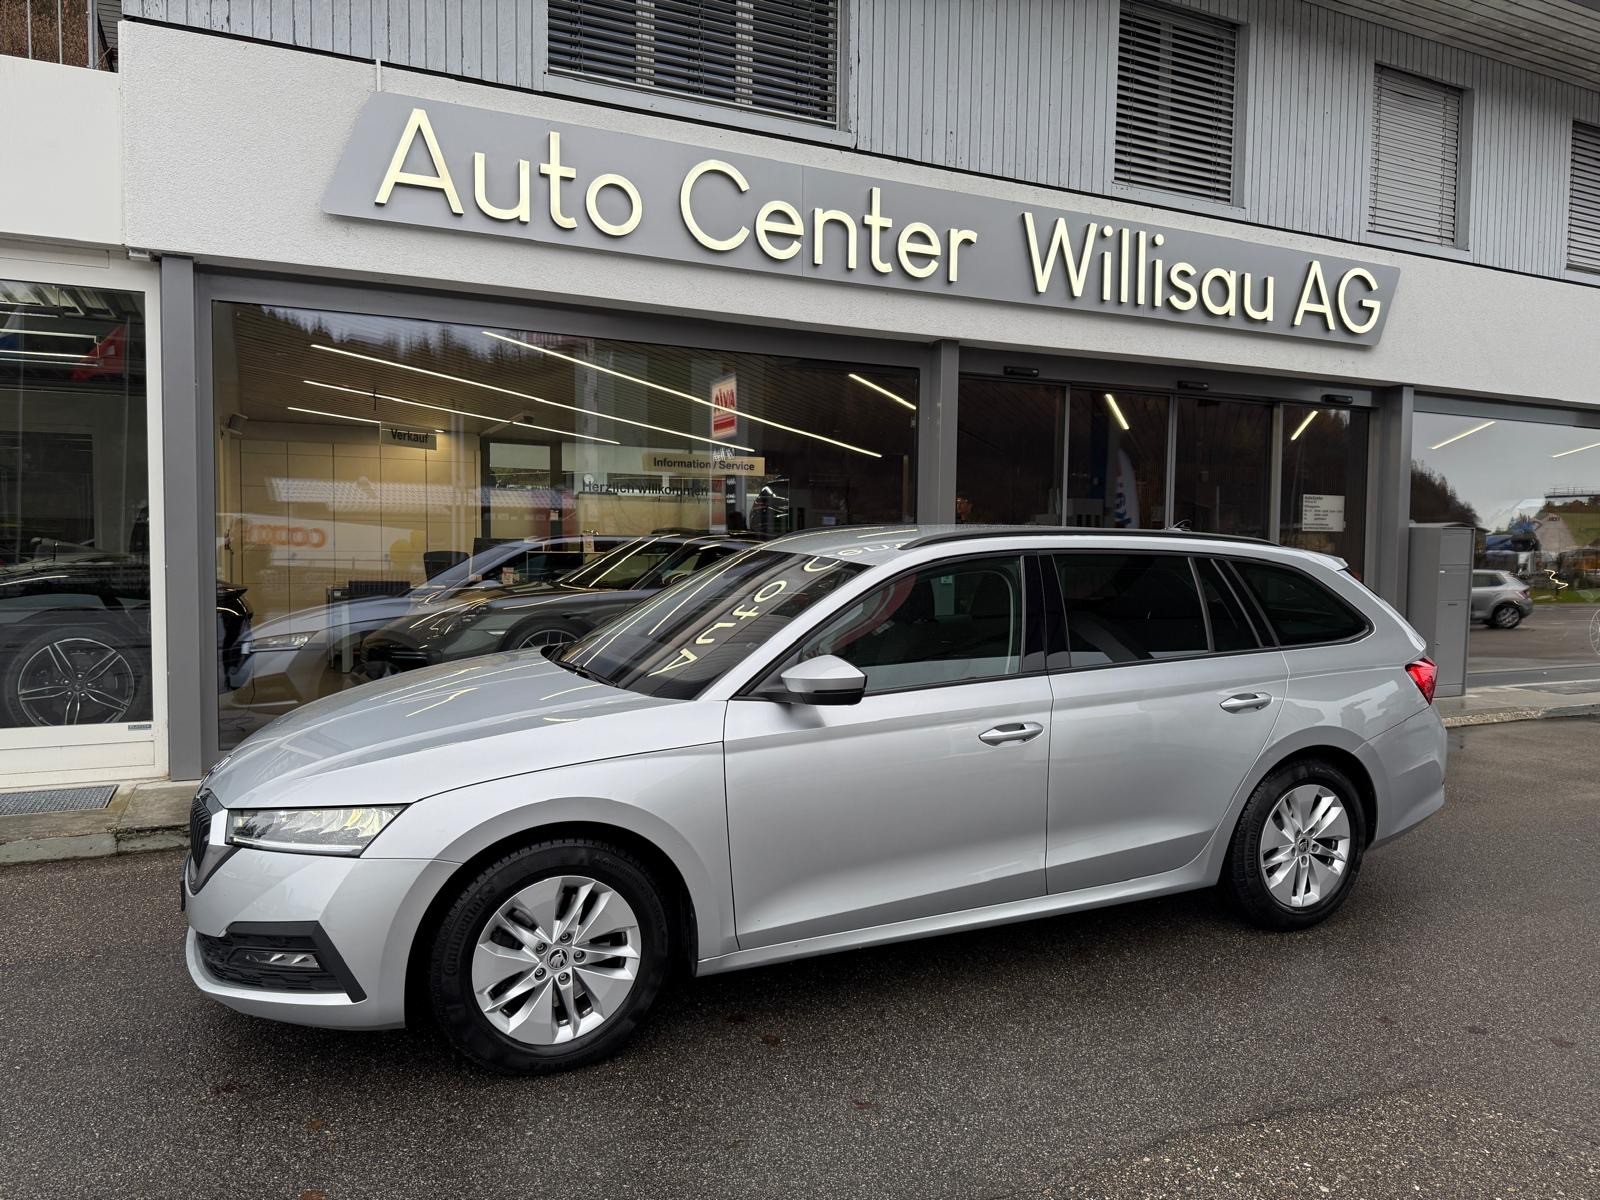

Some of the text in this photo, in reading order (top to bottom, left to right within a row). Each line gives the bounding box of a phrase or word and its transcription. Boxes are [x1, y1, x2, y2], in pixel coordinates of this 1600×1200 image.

[377, 107, 1382, 335] Auto Center Willisau AG
[391, 428, 428, 443] Verkauf
[653, 456, 710, 470] Information
[718, 460, 756, 471] Service
[582, 480, 709, 496] Herzlich willkommen
